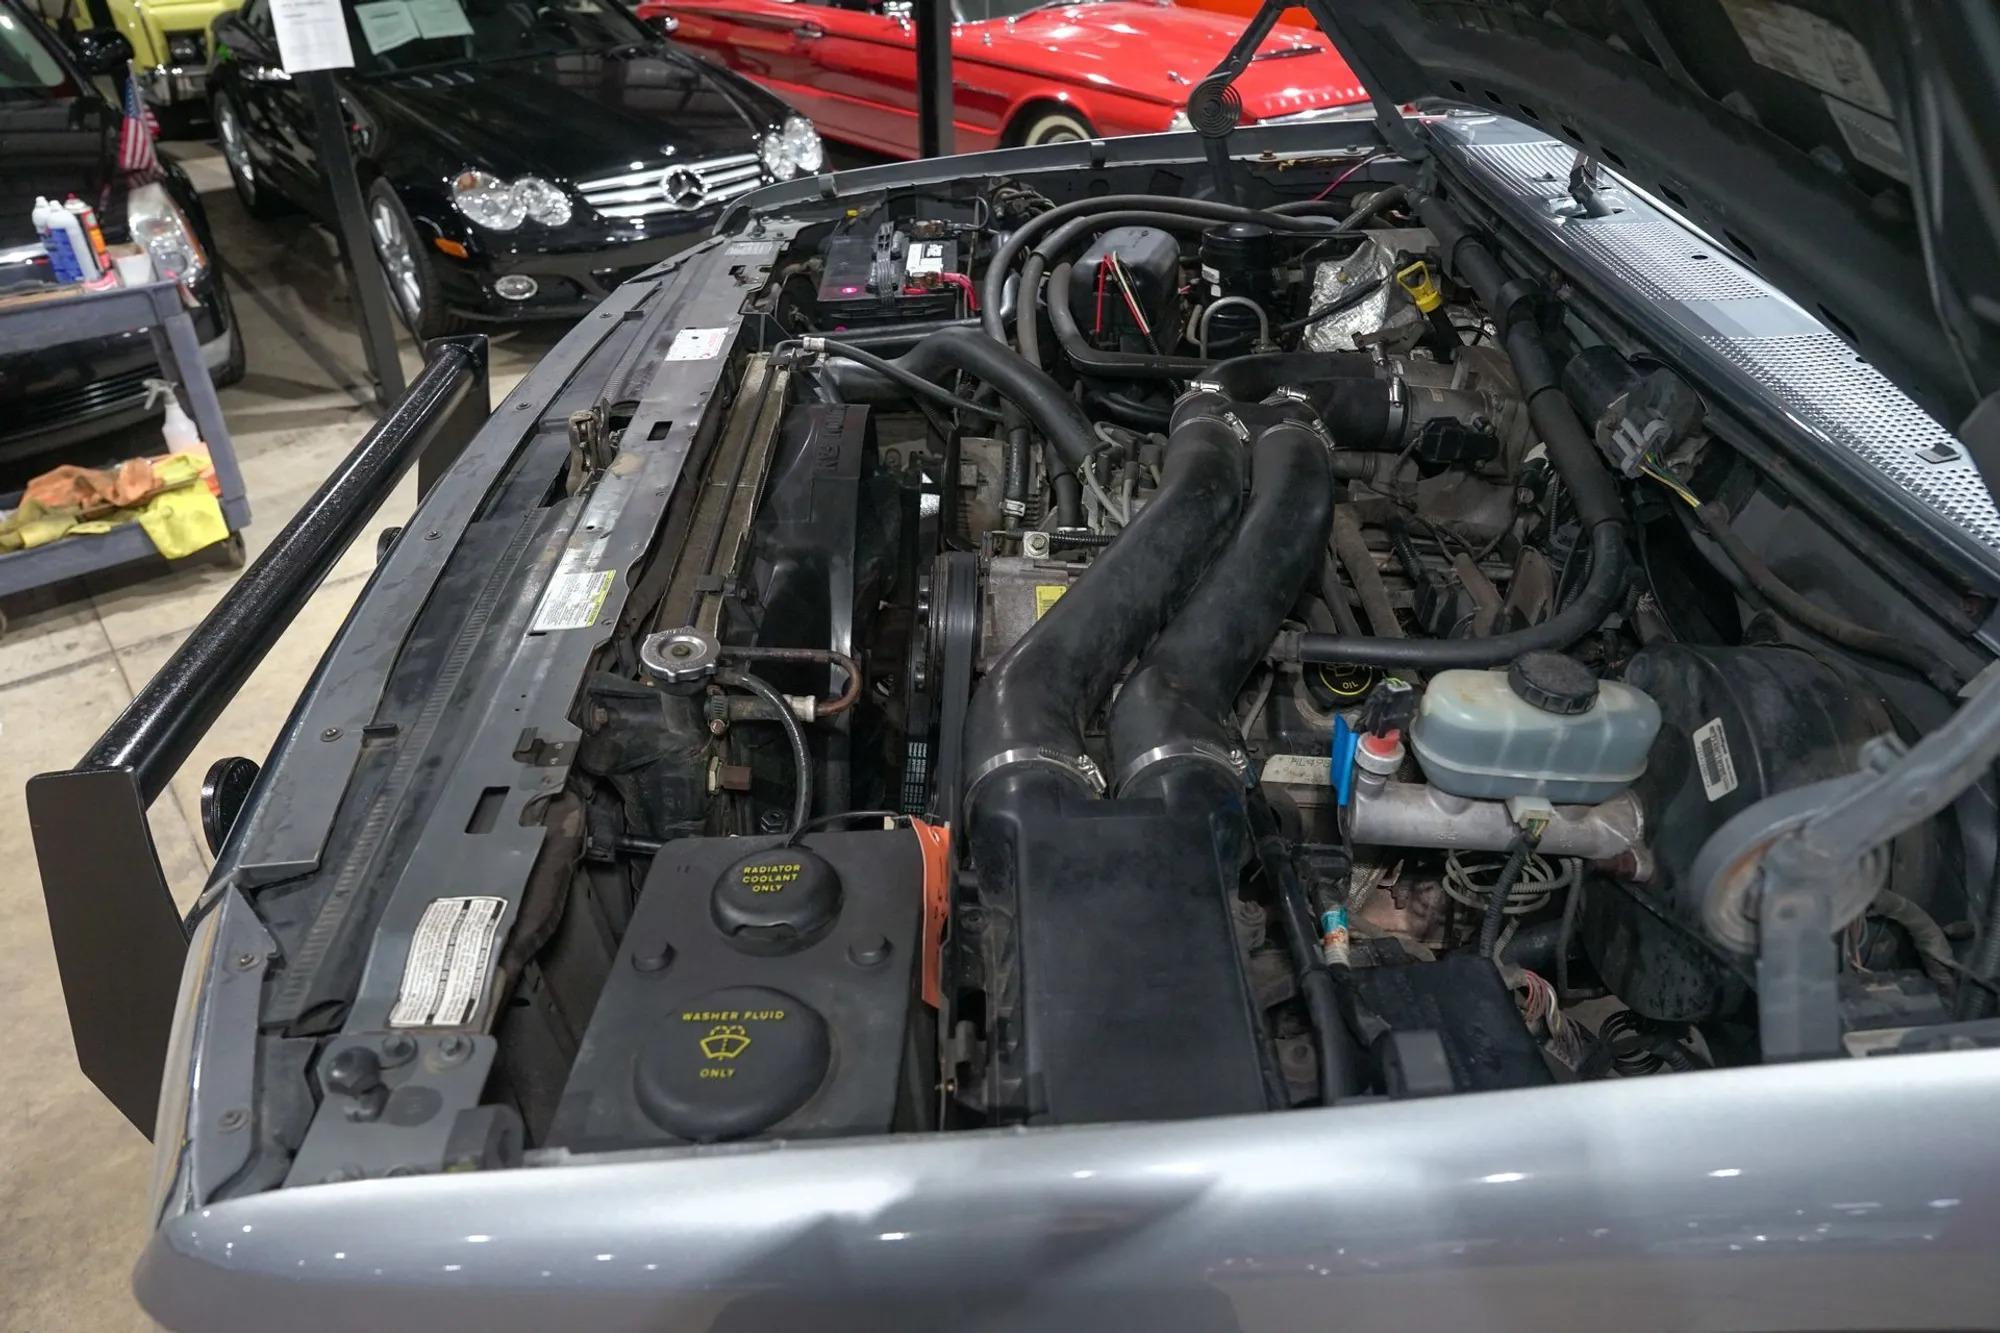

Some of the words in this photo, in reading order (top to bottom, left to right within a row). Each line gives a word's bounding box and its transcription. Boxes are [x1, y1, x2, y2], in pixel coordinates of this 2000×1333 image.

[1342, 680, 1359, 689] OIL
[743, 864, 801, 874] RADIATOR
[742, 873, 799, 884] COOLANT
[752, 884, 783, 893] ONLY
[682, 1011, 739, 1021] WASHER
[743, 1010, 785, 1020] FLUID
[699, 1067, 736, 1079] ONLY
